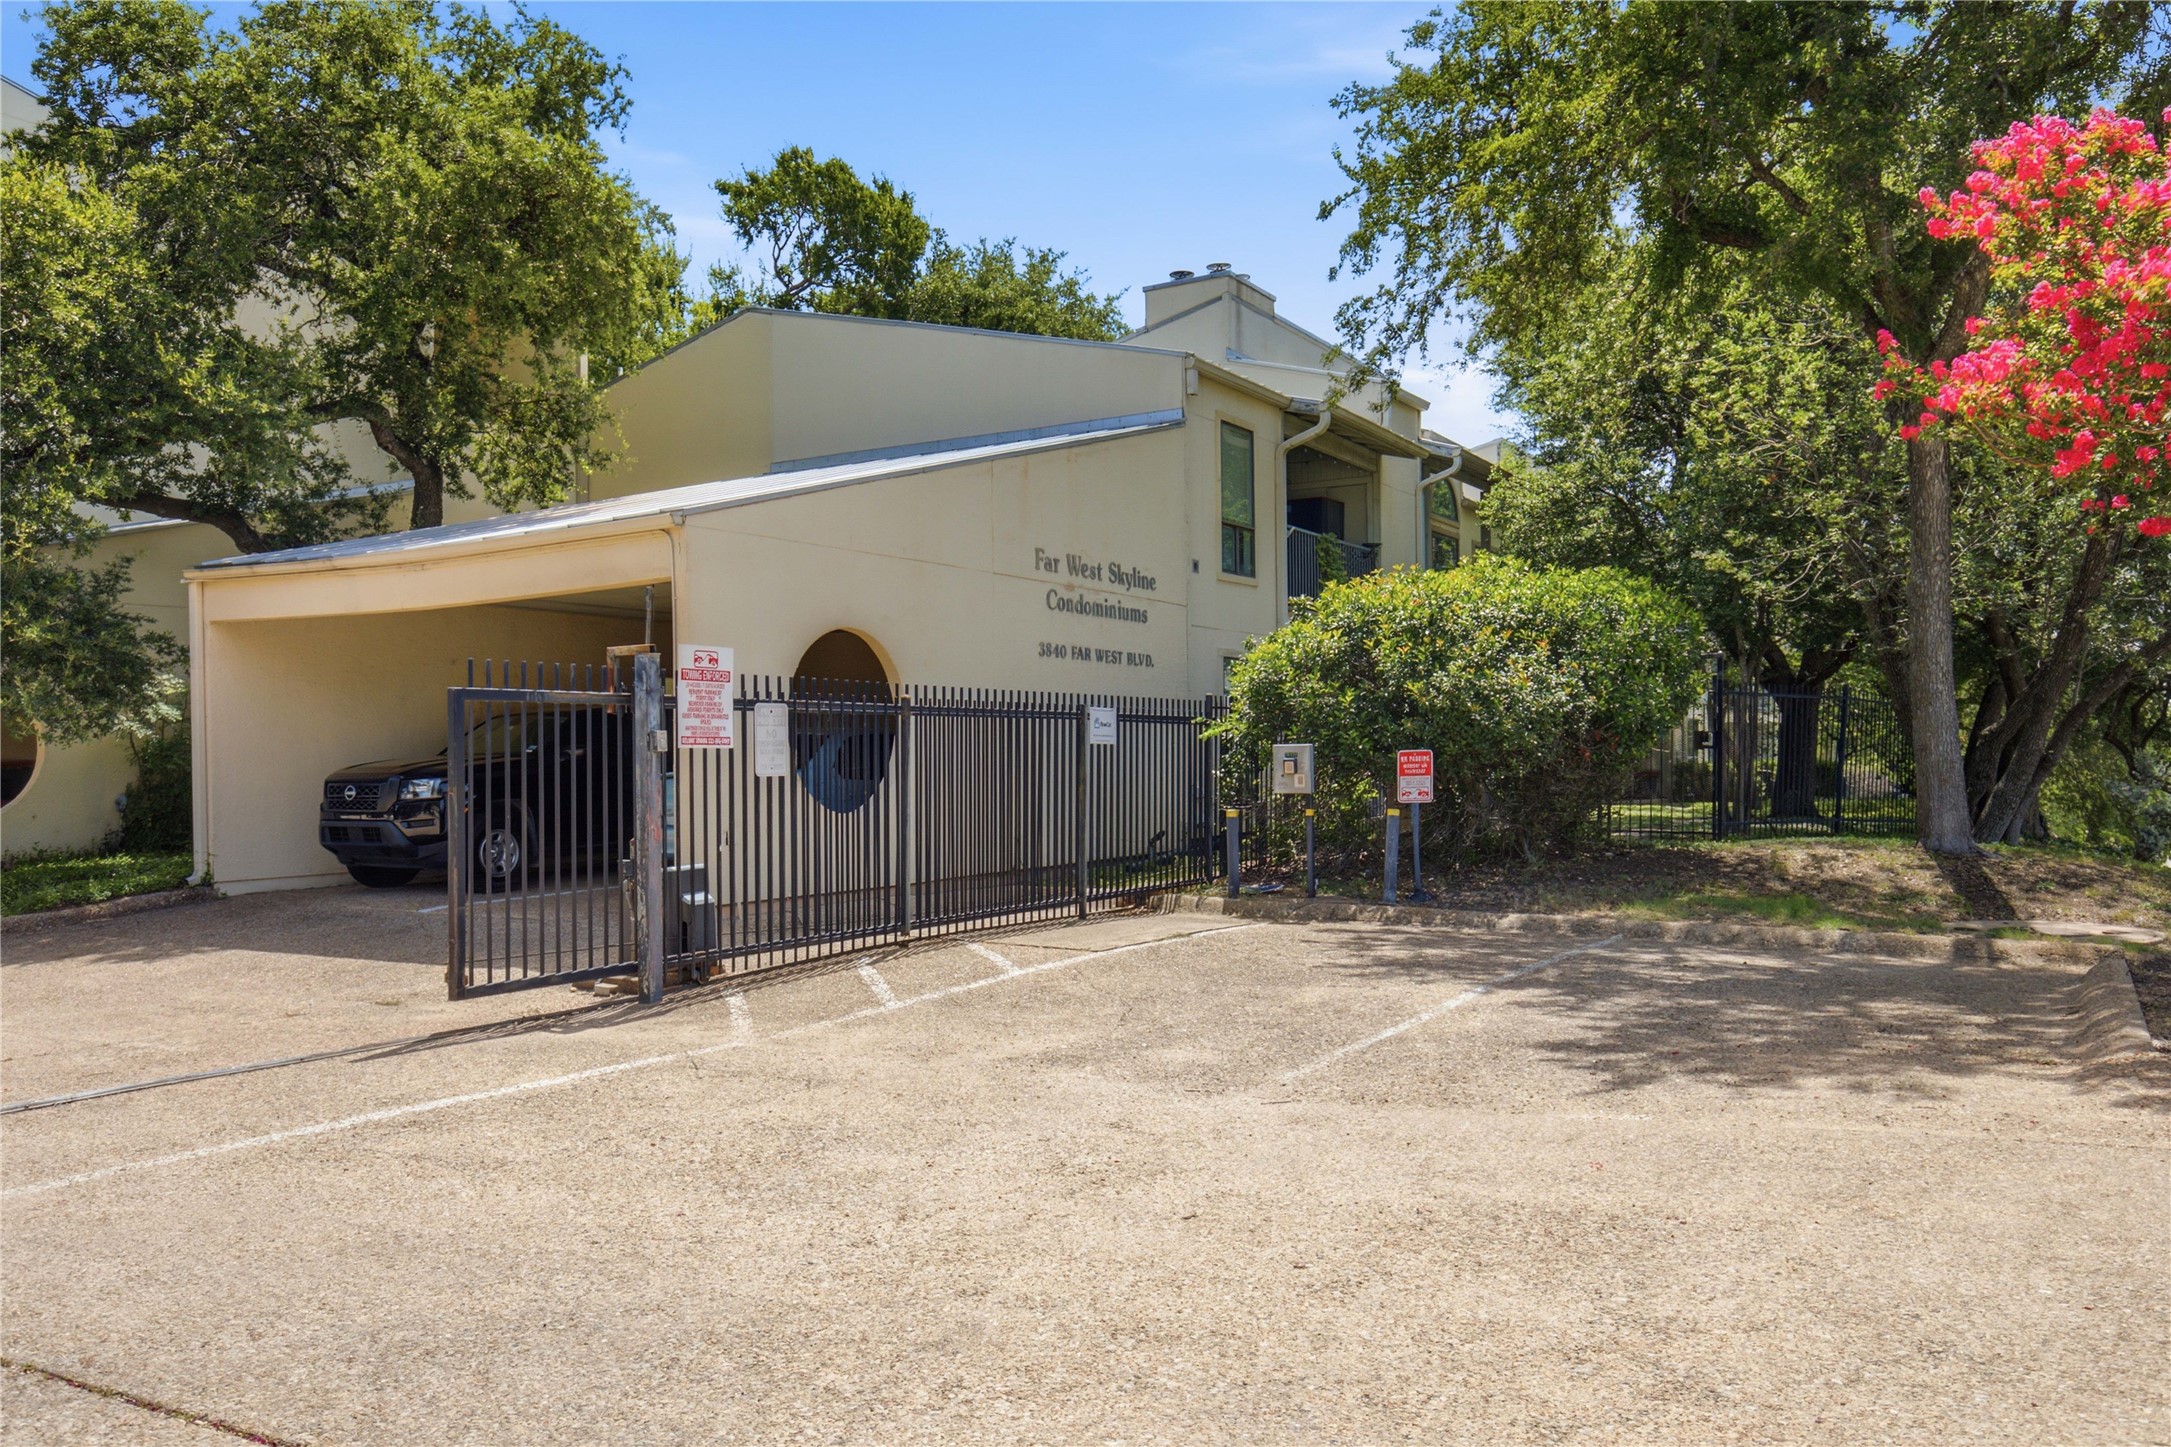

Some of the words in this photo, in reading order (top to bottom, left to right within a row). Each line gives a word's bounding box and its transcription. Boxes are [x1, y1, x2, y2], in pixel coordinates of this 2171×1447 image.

[1034, 547, 1060, 573] Far
[1066, 553, 1103, 582] West
[1108, 562, 1157, 591] Skyline
[1046, 588, 1148, 624] Condominiums
[1038, 641, 1067, 659] 3840
[1071, 645, 1092, 661] FAR
[1095, 648, 1123, 665] WEST
[1127, 652, 1155, 668] BLVD.
[682, 669, 703, 680] TOWING
[703, 670, 729, 682] ENFORCED
